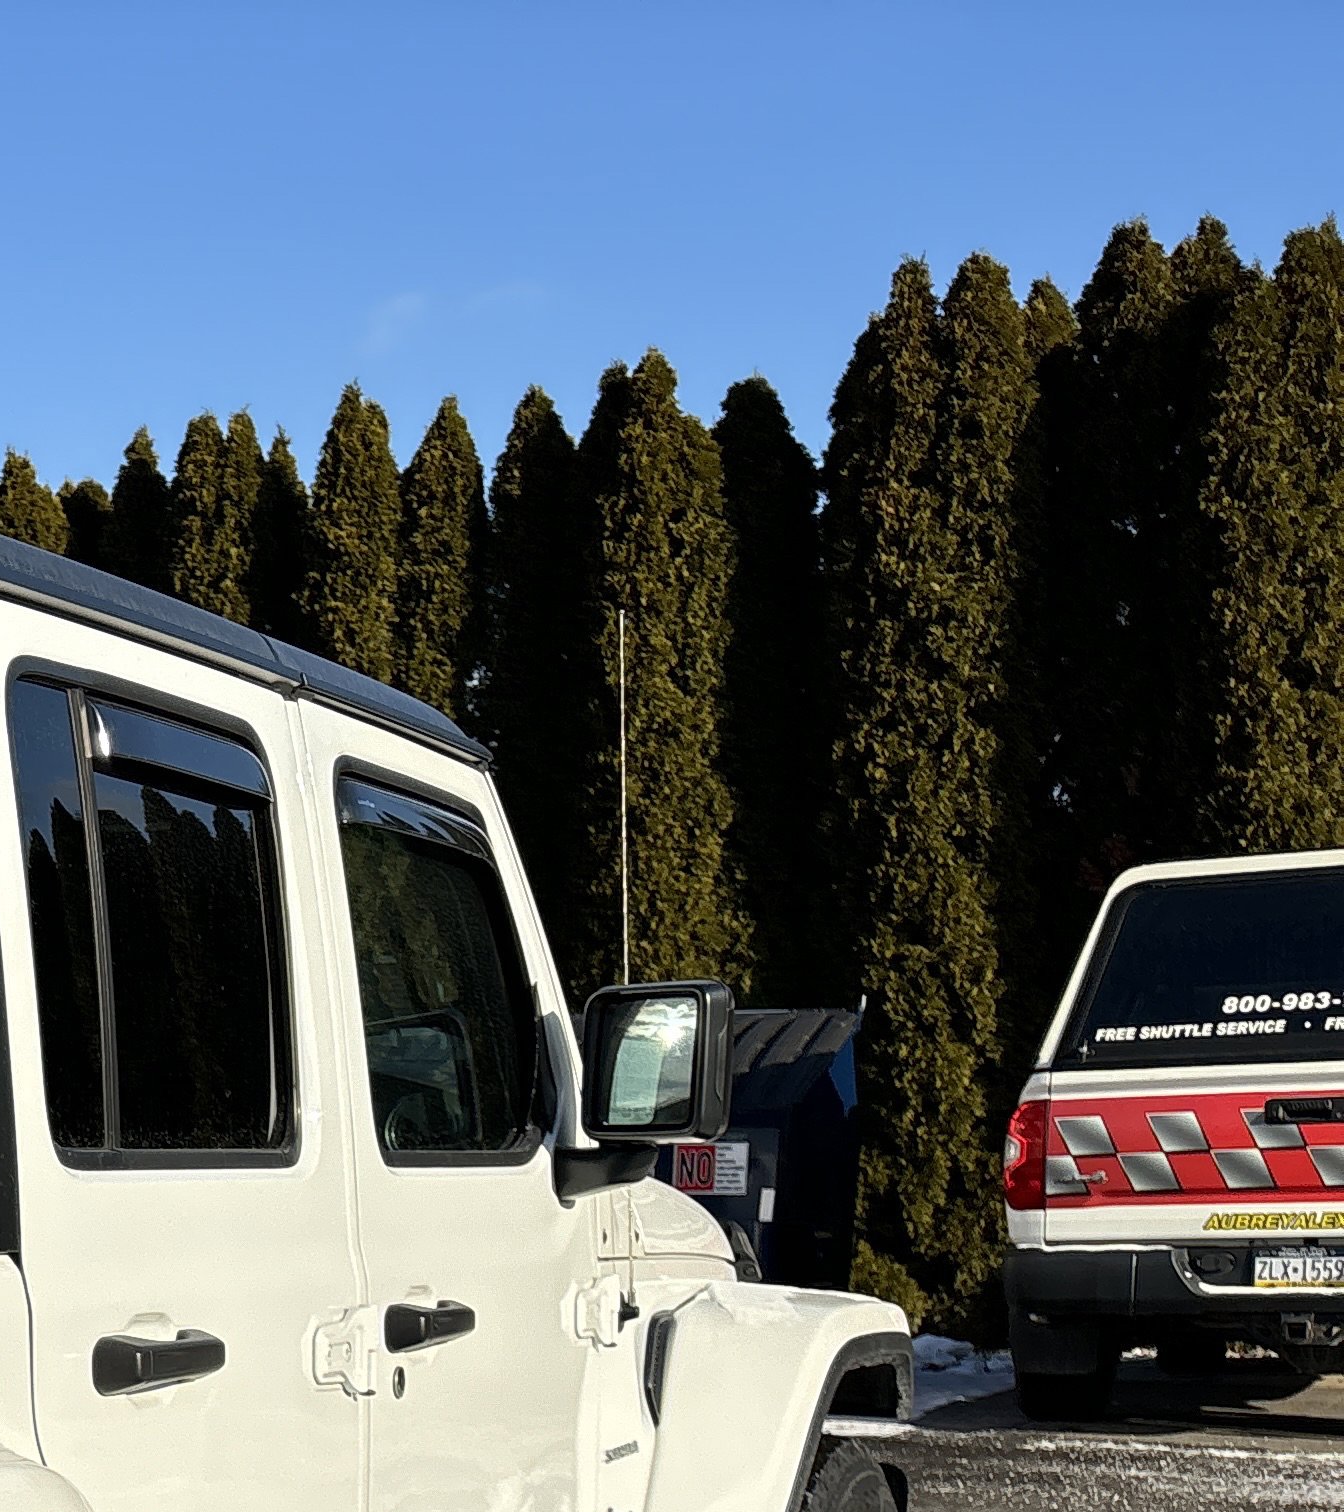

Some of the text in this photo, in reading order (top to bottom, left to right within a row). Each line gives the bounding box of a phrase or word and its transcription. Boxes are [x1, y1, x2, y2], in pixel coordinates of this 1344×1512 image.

[1222, 991, 1344, 1014] 800-983-
[1095, 1027, 1137, 1042] FREE
[1139, 1023, 1212, 1040] SHUTTLE
[1216, 1019, 1287, 1036] SERVICE
[679, 1149, 712, 1185] NO
